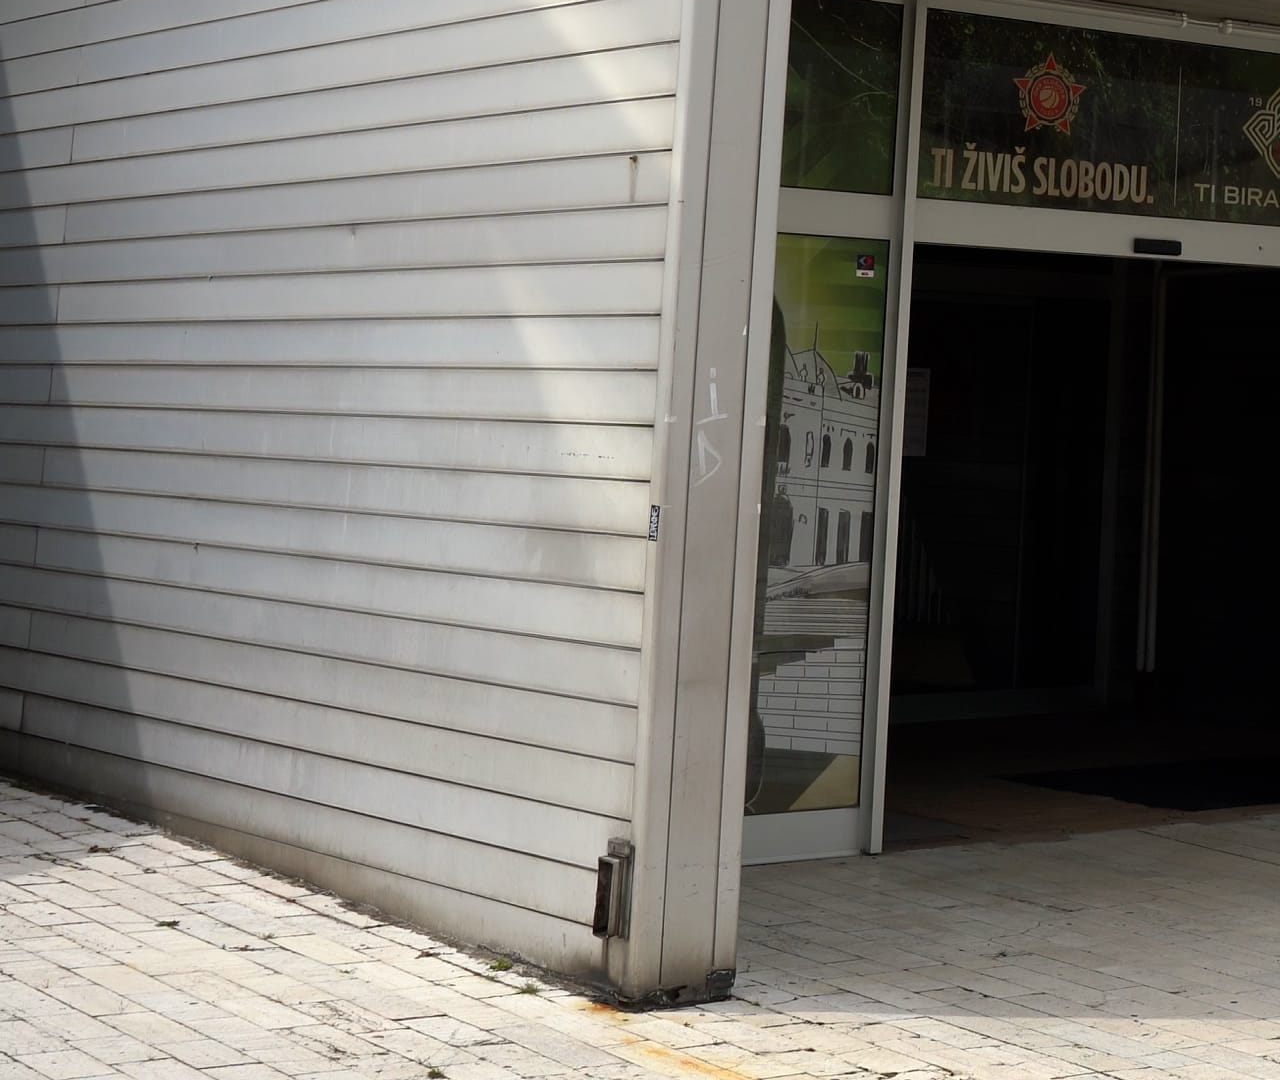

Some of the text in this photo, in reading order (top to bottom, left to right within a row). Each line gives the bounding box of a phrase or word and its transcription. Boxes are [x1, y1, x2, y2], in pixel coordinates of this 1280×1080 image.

[1249, 97, 1262, 107] 19
[930, 142, 1154, 204] TI ŽIVIŠ SLOBODU.
[1194, 183, 1215, 203] TI
